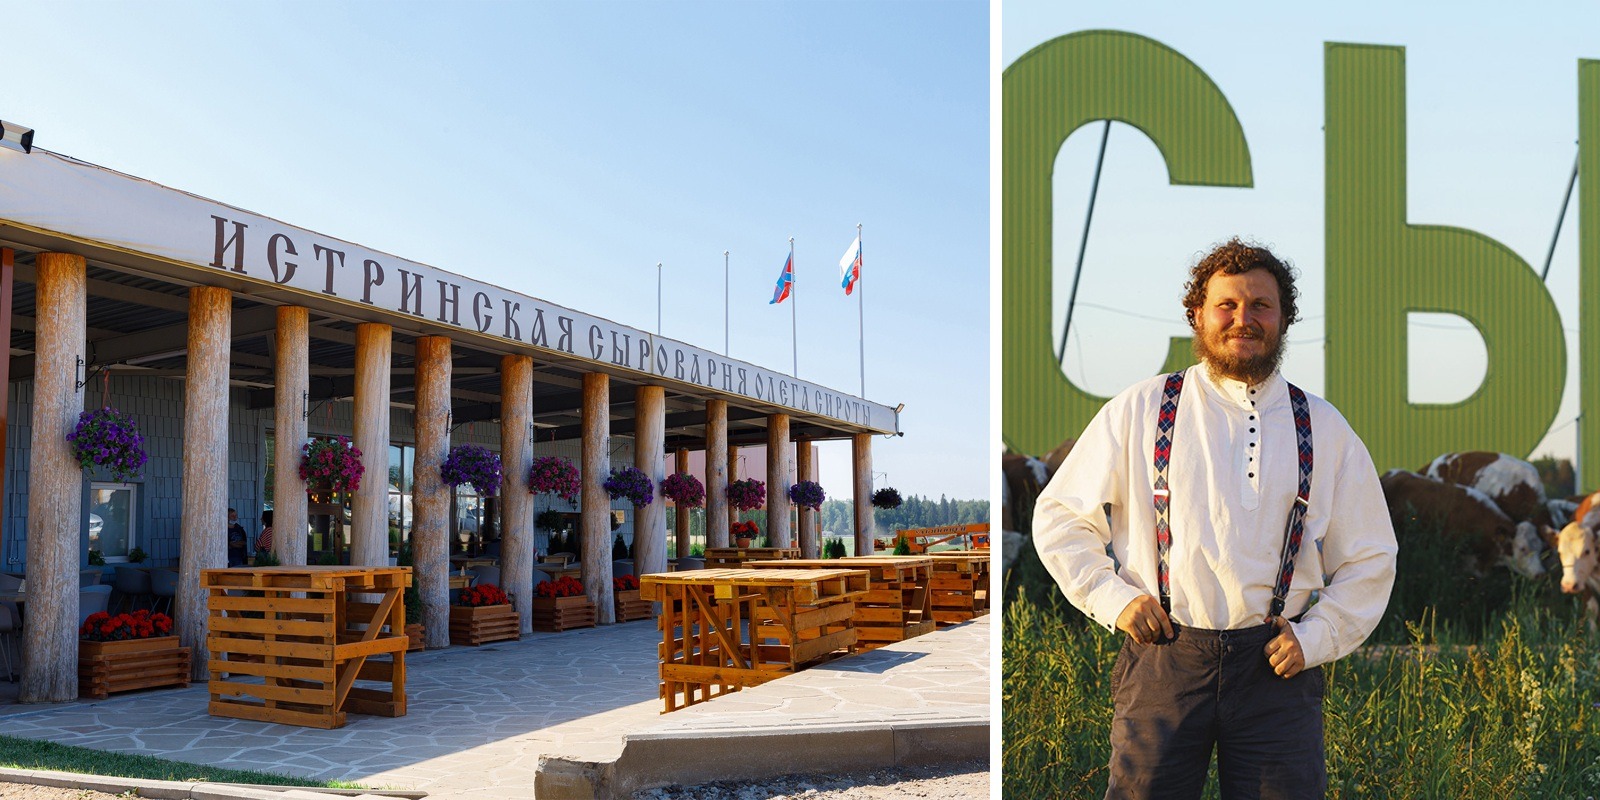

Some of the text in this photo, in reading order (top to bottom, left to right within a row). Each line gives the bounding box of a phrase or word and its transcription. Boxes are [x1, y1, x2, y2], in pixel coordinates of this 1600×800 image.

[209, 214, 871, 427] ИСТРИНСКАЯ СЫРОВАРНЯ ОЛЕГА СИРОТЫ
